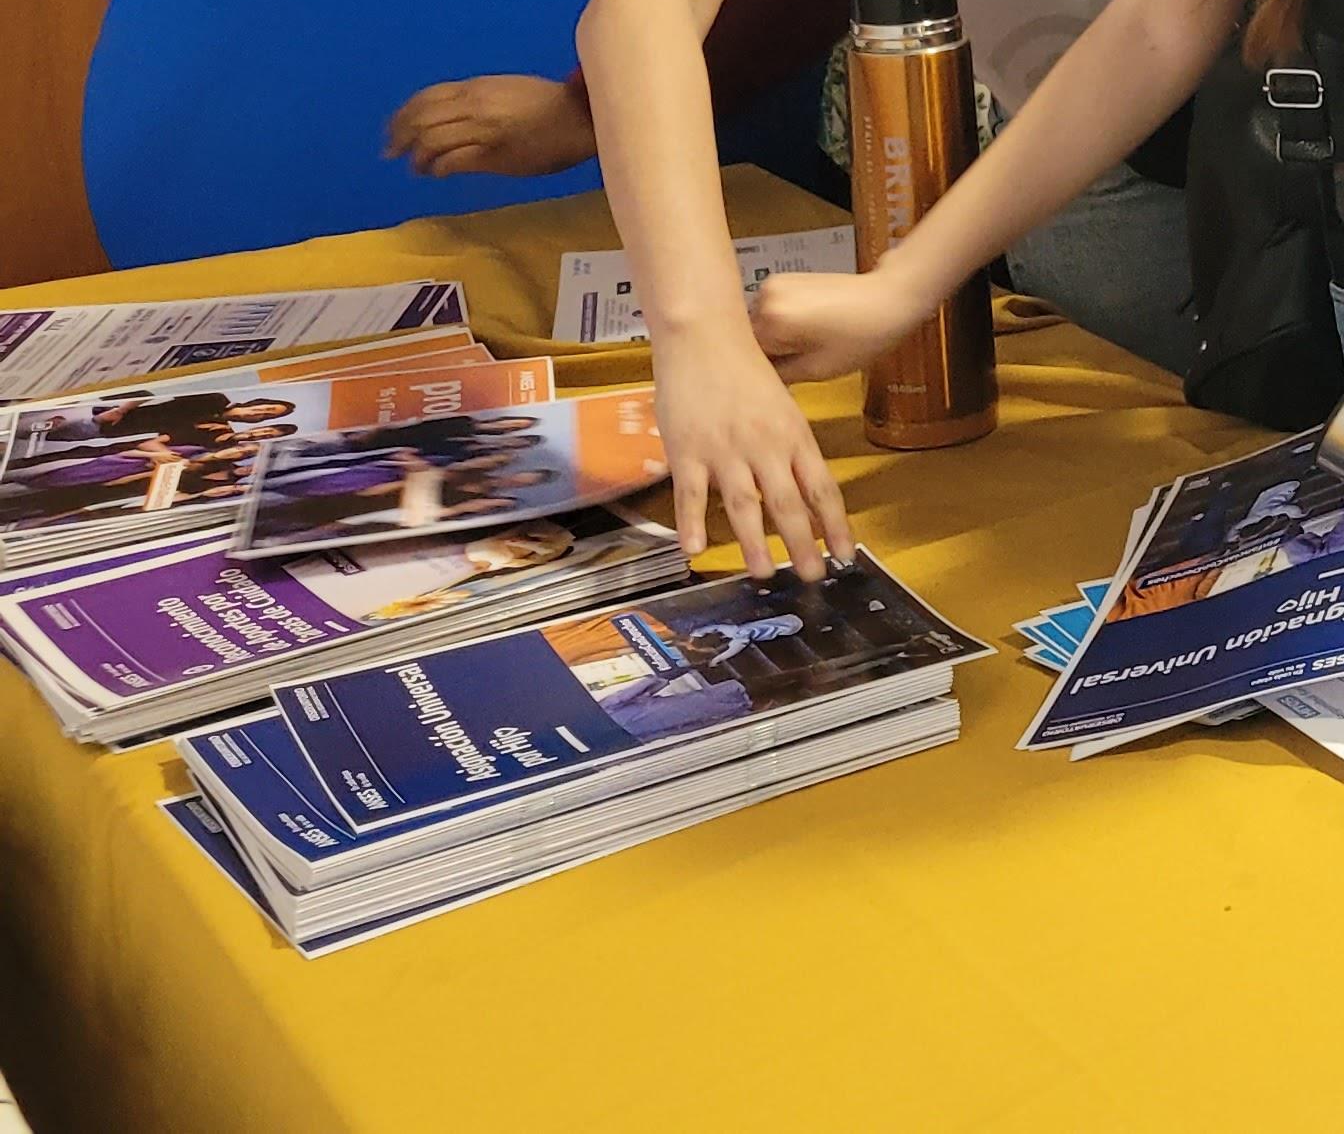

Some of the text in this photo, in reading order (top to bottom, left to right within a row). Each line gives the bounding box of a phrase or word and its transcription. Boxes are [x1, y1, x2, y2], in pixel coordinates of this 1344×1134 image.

[1069, 645, 1217, 695] Universal
[384, 662, 502, 782] Asignación Universal
[511, 749, 559, 768] por
